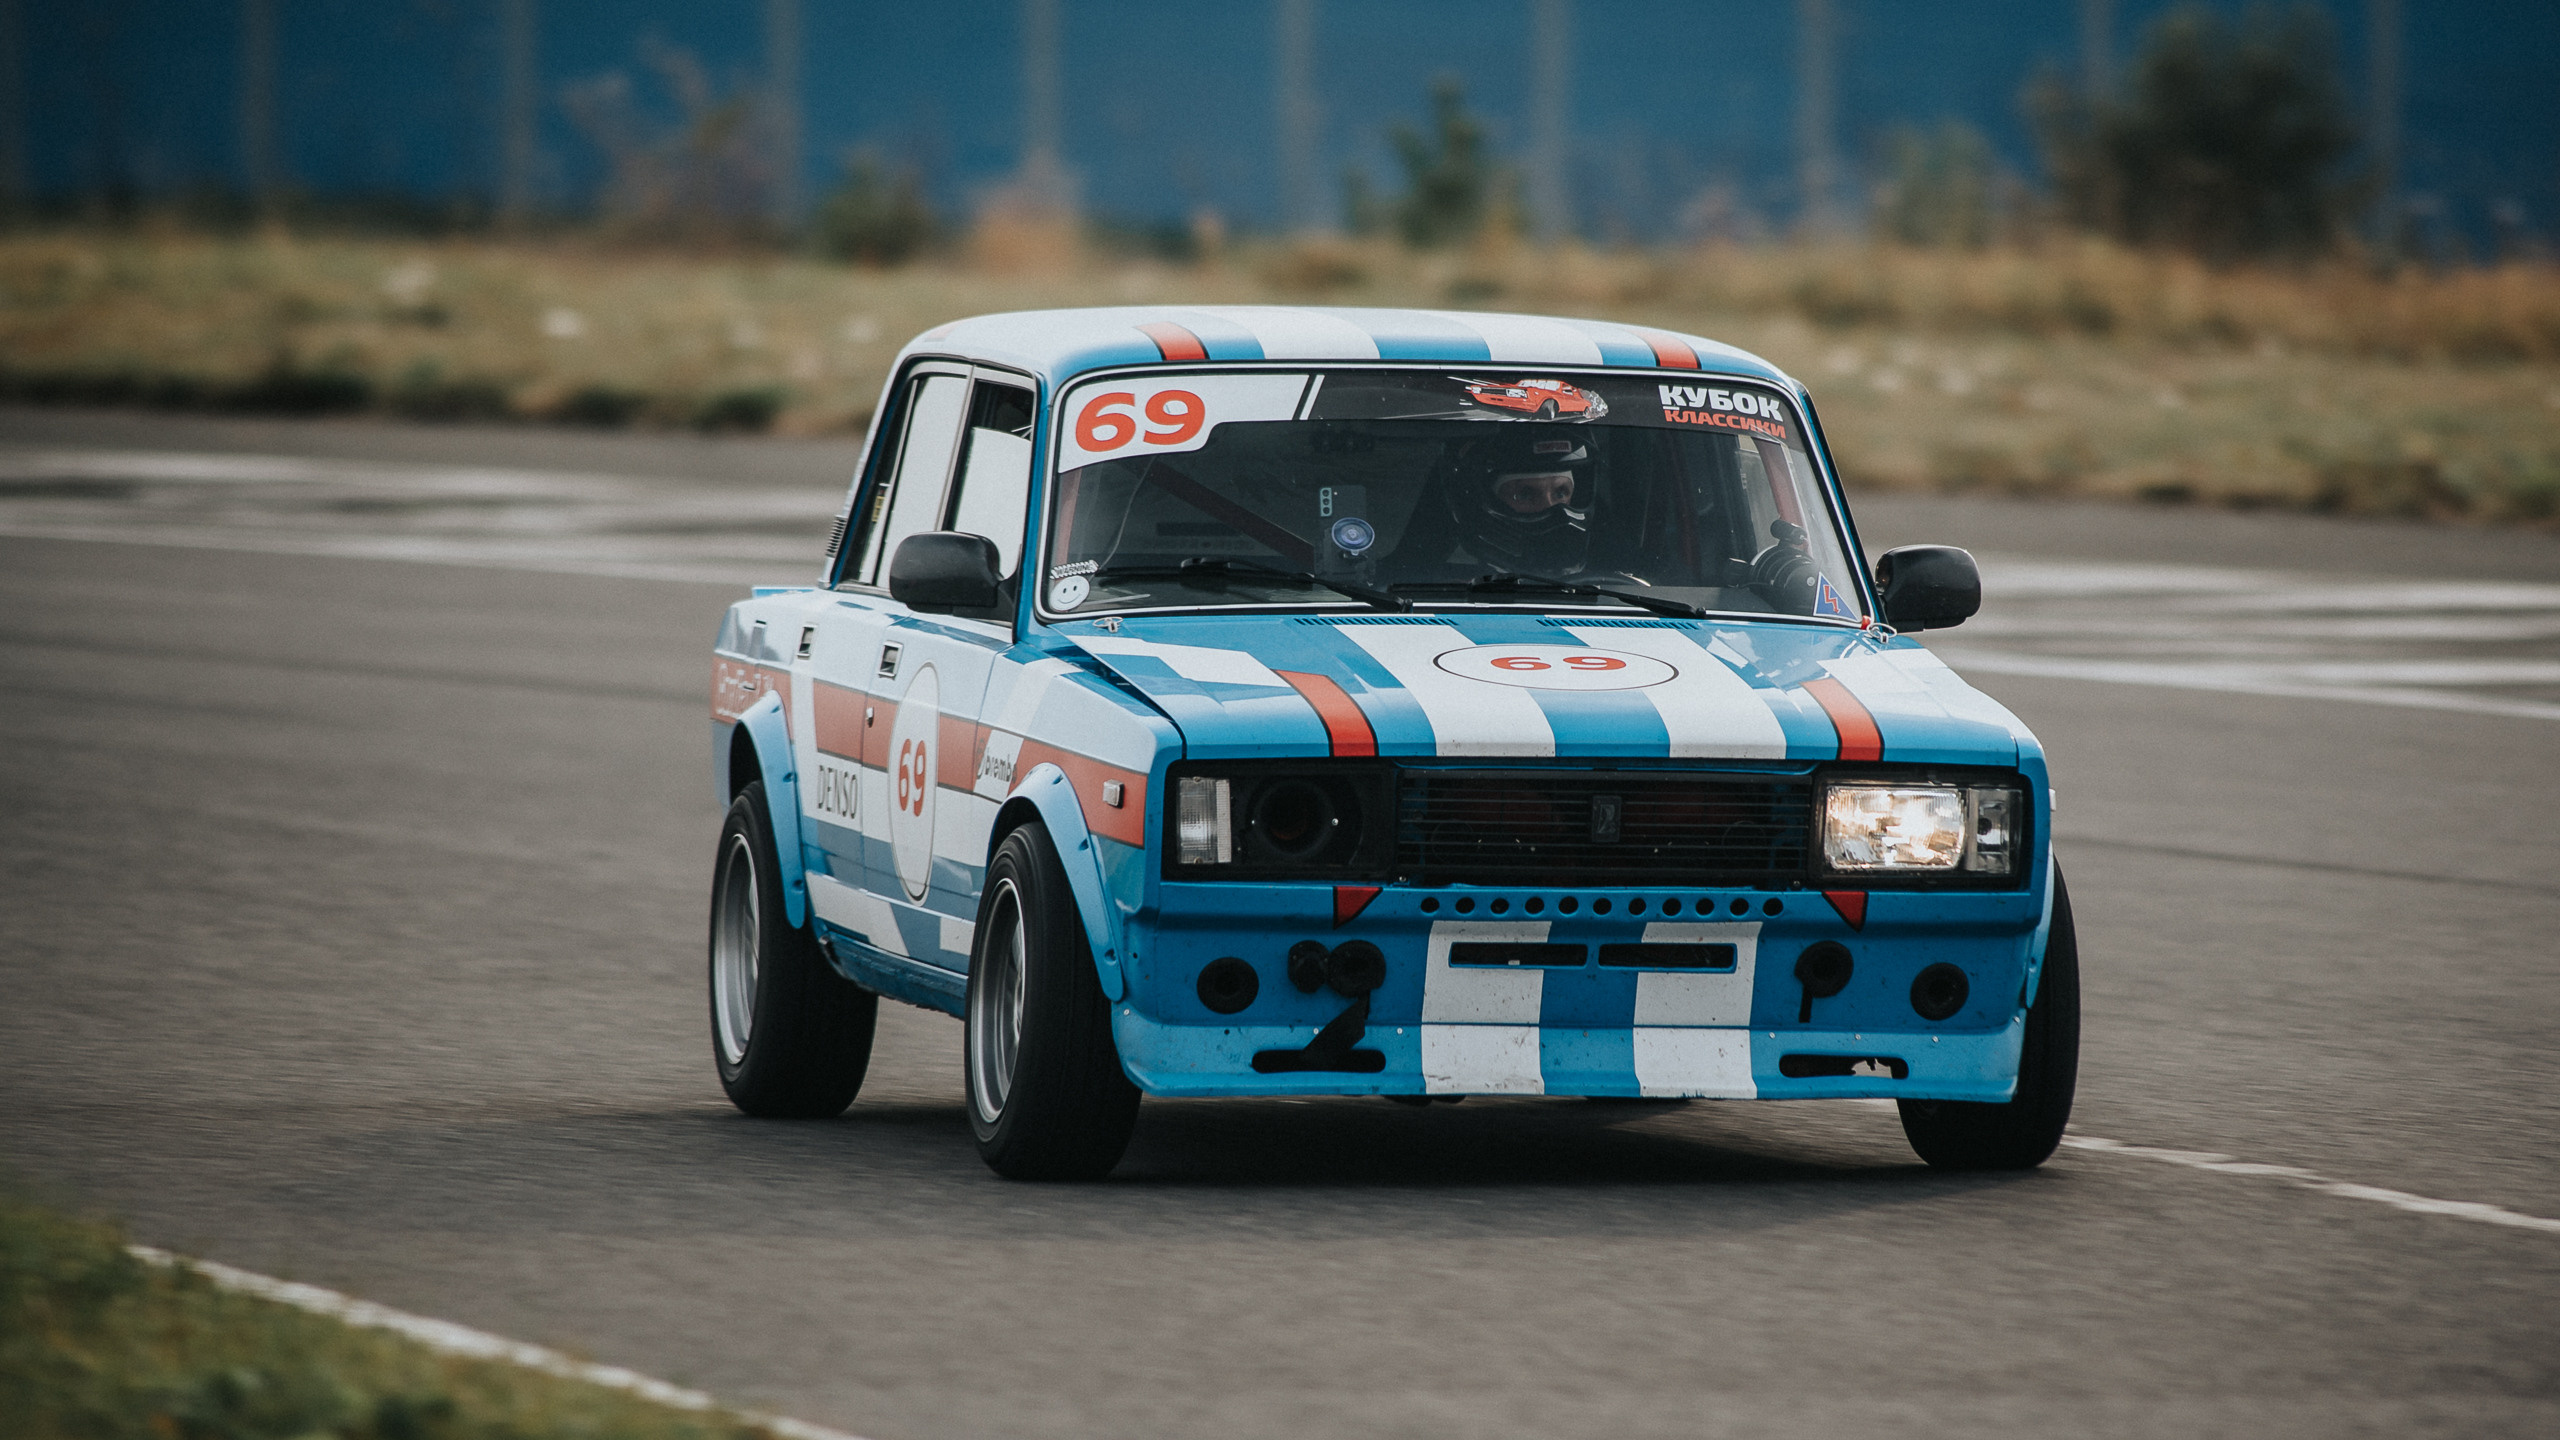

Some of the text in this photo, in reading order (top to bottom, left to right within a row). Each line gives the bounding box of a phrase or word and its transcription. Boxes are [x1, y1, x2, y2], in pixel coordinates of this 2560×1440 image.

[1075, 389, 1206, 452] 69
[1658, 384, 1784, 422] КУБОК
[1664, 409, 1787, 439] КЛАССИКИ
[1490, 656, 1627, 671] 69
[817, 765, 858, 819] DENSO
[898, 738, 926, 817] 69
